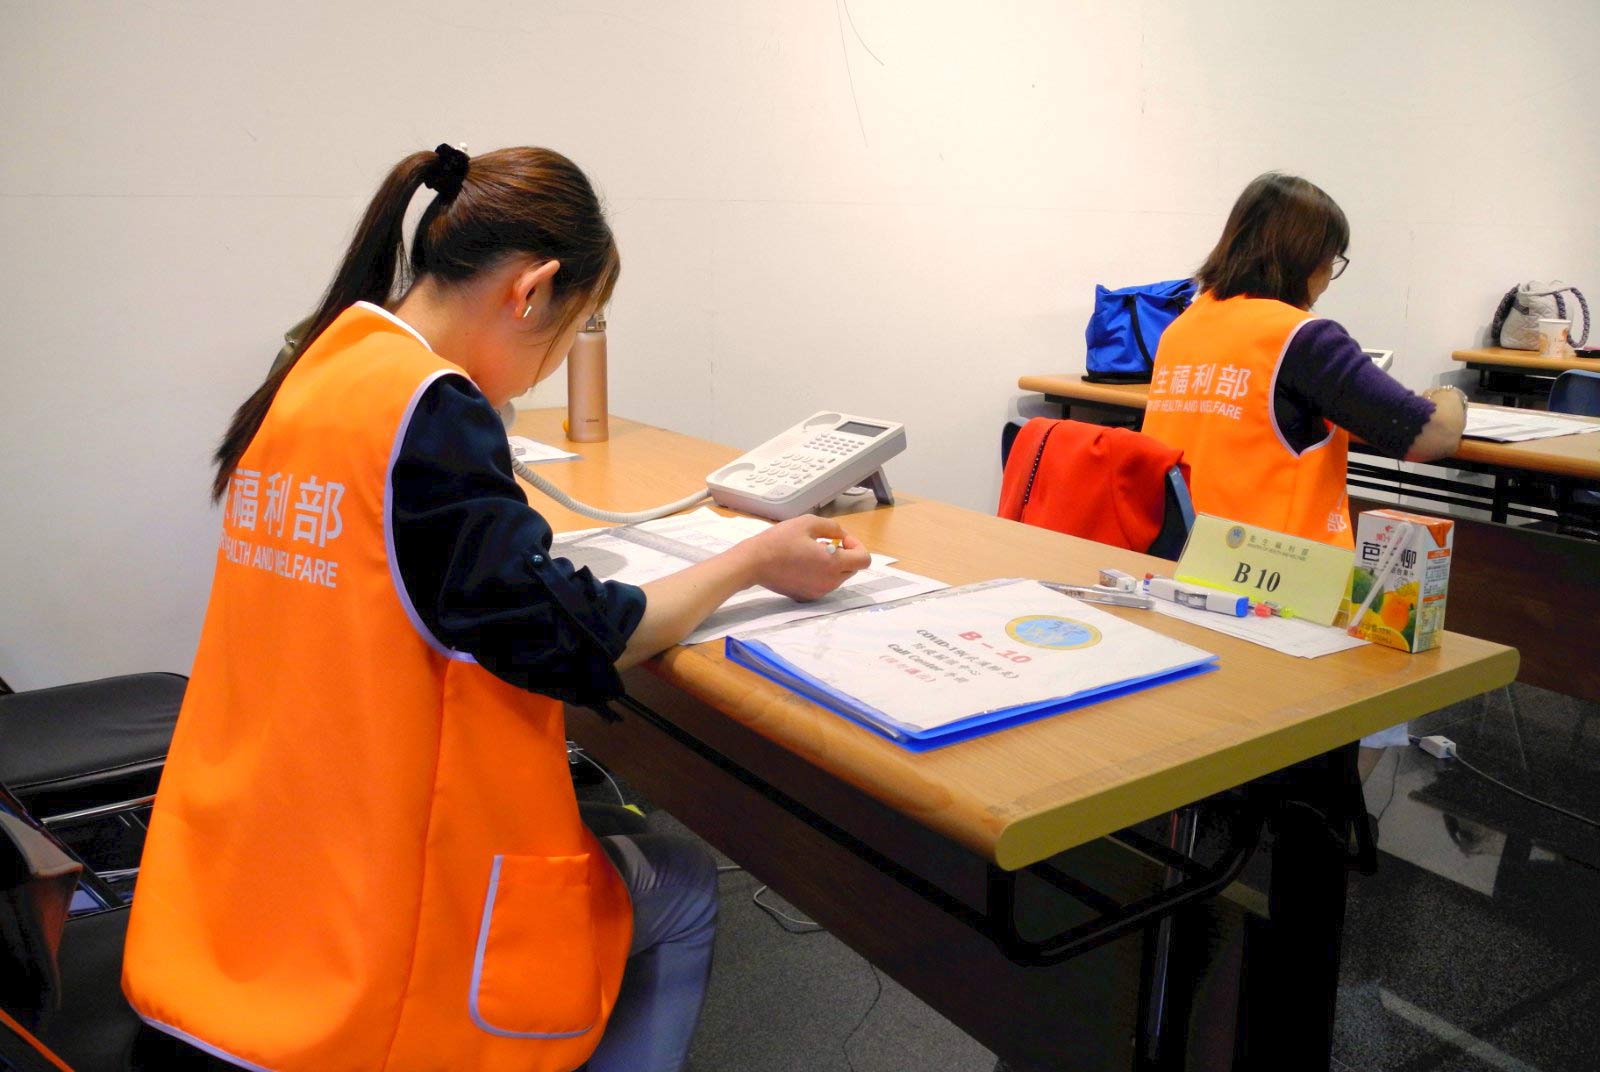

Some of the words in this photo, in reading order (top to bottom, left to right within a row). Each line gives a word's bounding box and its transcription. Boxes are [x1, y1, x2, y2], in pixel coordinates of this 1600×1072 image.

[252, 545, 274, 571] AND
[275, 550, 338, 588] WELFARE
[1232, 562, 1251, 584] B
[1254, 568, 1281, 593] 10
[888, 643, 911, 656] Call
